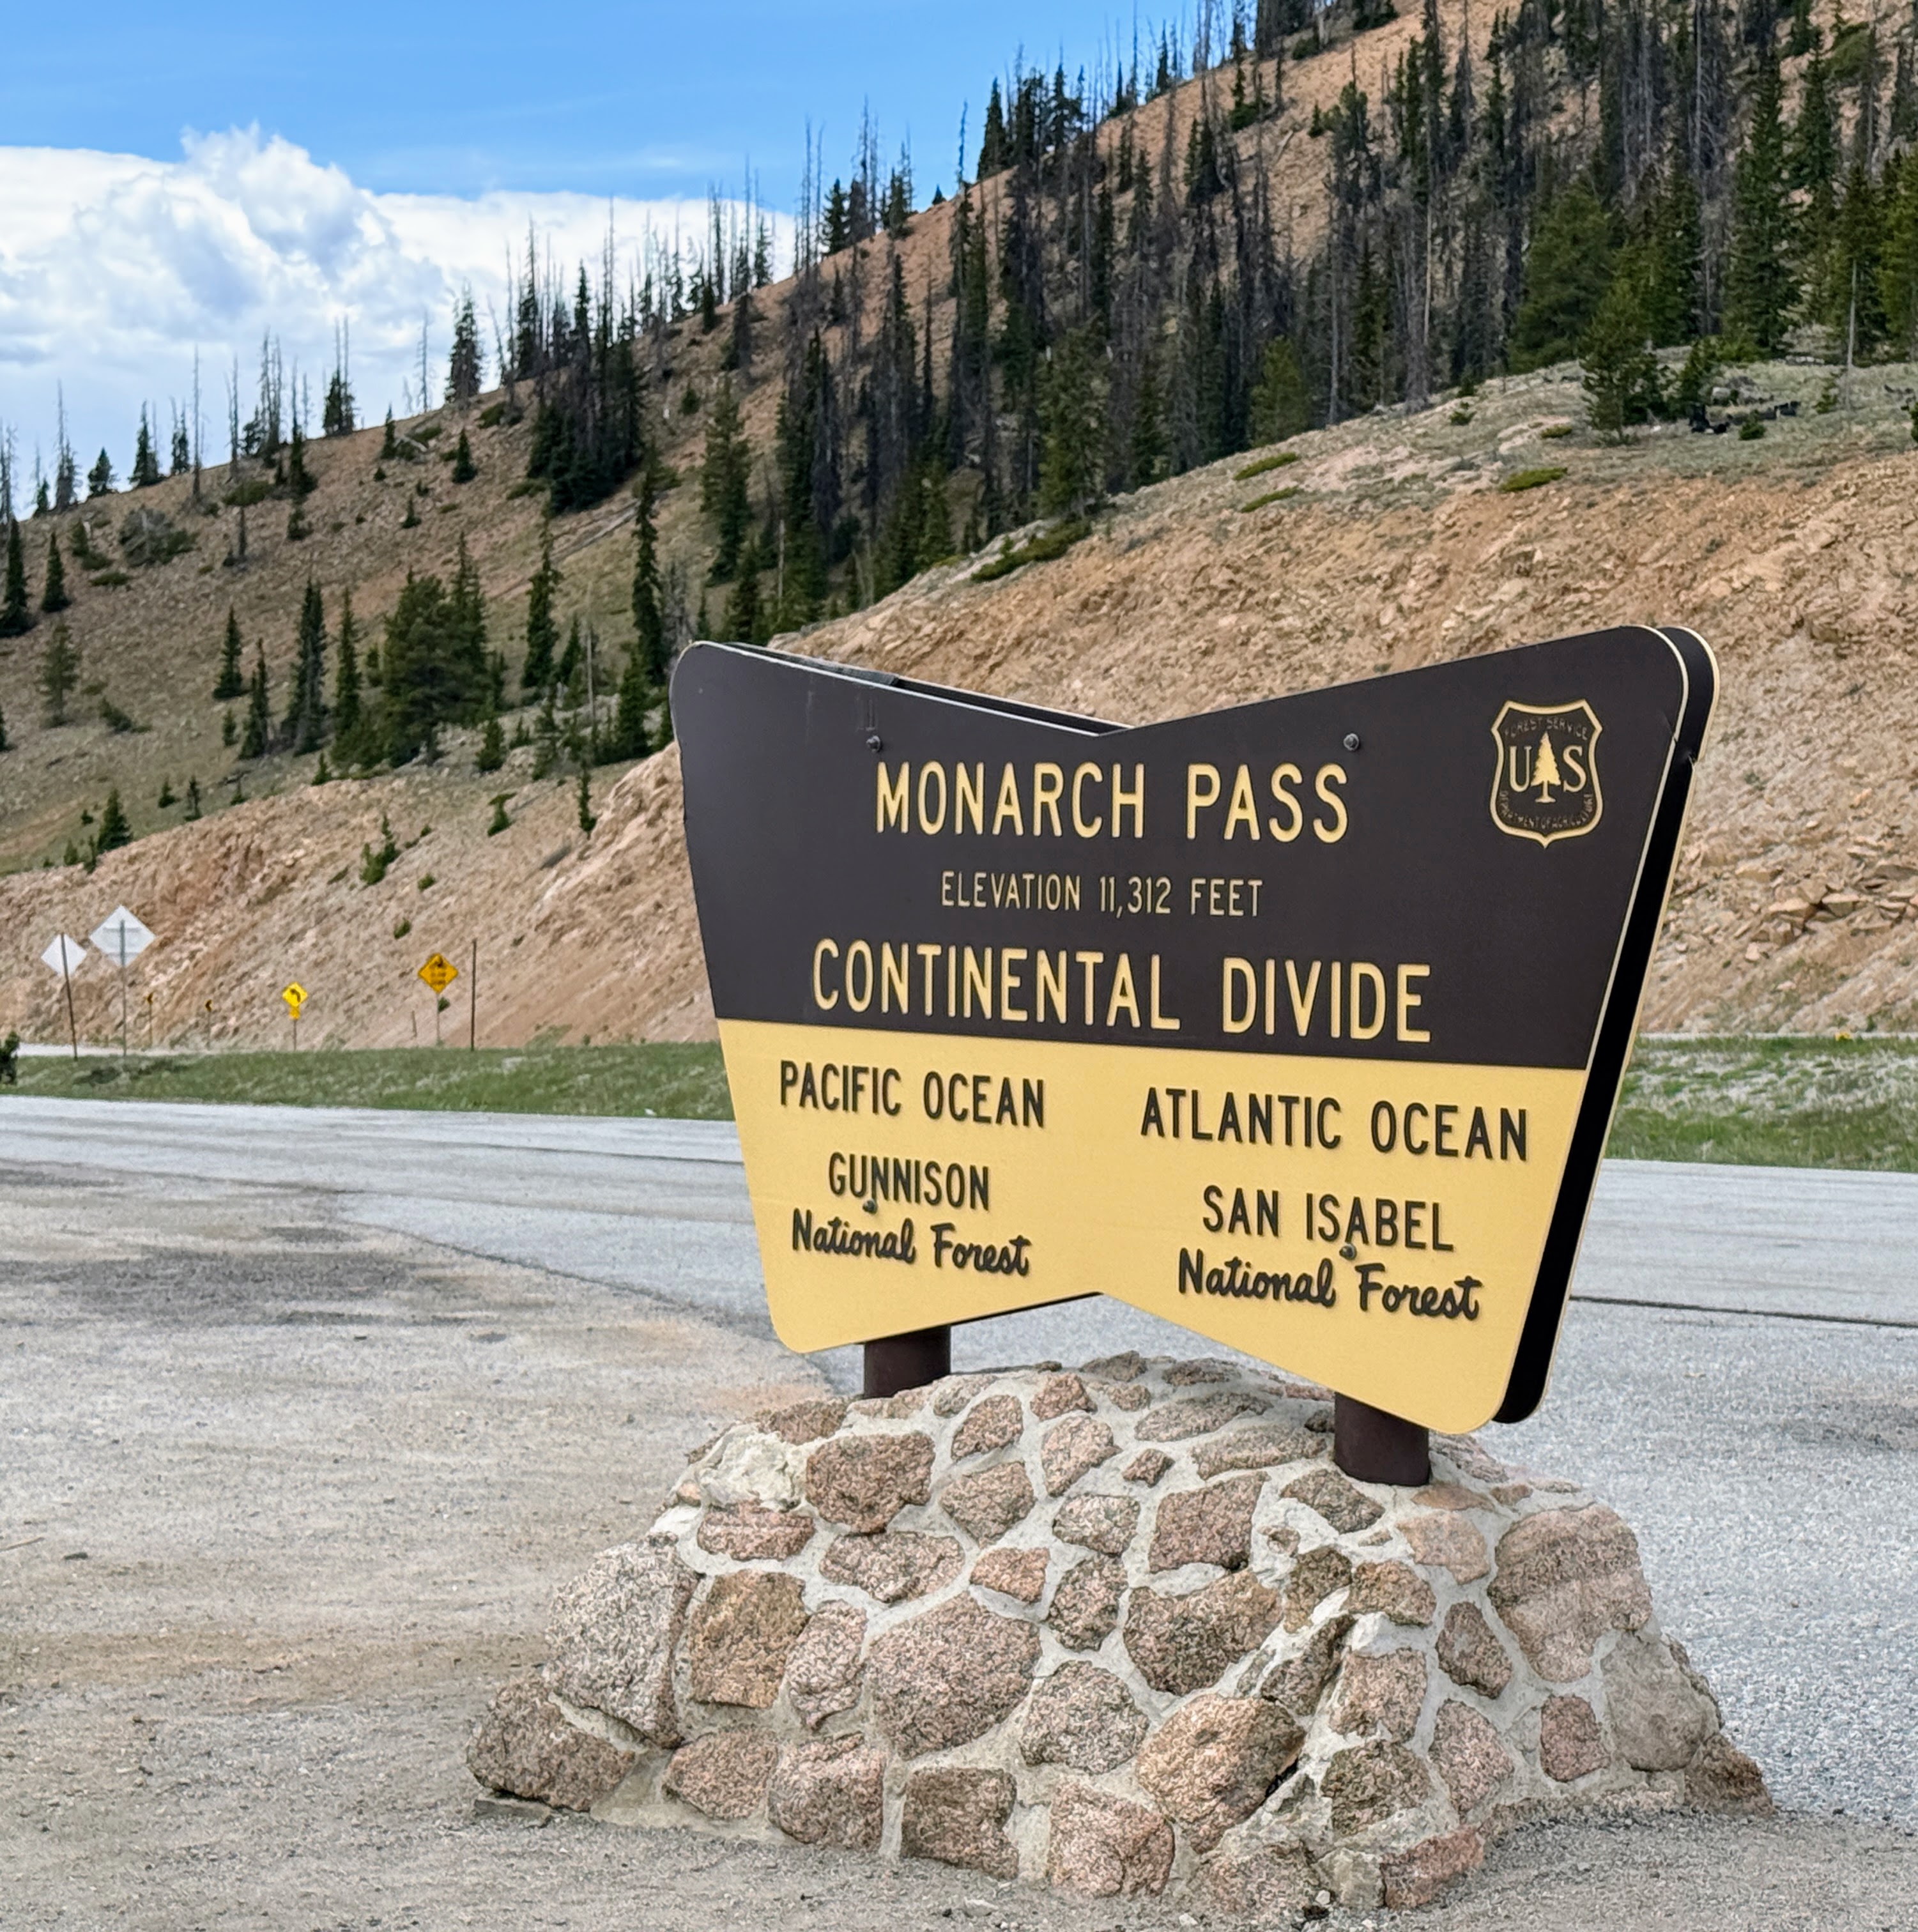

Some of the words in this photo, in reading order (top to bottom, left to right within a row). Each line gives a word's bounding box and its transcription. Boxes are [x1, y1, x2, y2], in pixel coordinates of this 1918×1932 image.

[1546, 716, 1588, 740] SERVICE
[877, 761, 1144, 838] MONARCH
[1187, 763, 1347, 843] PASS
[942, 871, 1080, 910] ELEVATION
[1100, 877, 1171, 917] 11,312
[1191, 878, 1262, 916] FEET
[813, 939, 1180, 1030] CONTINENTAL
[1223, 958, 1431, 1043] DIVIDE
[780, 1060, 901, 1117] PACIFIC
[923, 1071, 1044, 1129] OCEAN
[1140, 1087, 1342, 1150] ATLANTIC
[1370, 1100, 1527, 1162] OCEAN
[829, 1152, 989, 1210] GUNNISON
[793, 1208, 916, 1264] National
[930, 1222, 1031, 1276] Forest
[1202, 1184, 1279, 1238] SAN
[1306, 1193, 1454, 1251] ISABEL
[1178, 1247, 1336, 1308] National
[1355, 1262, 1483, 1321] Forest
